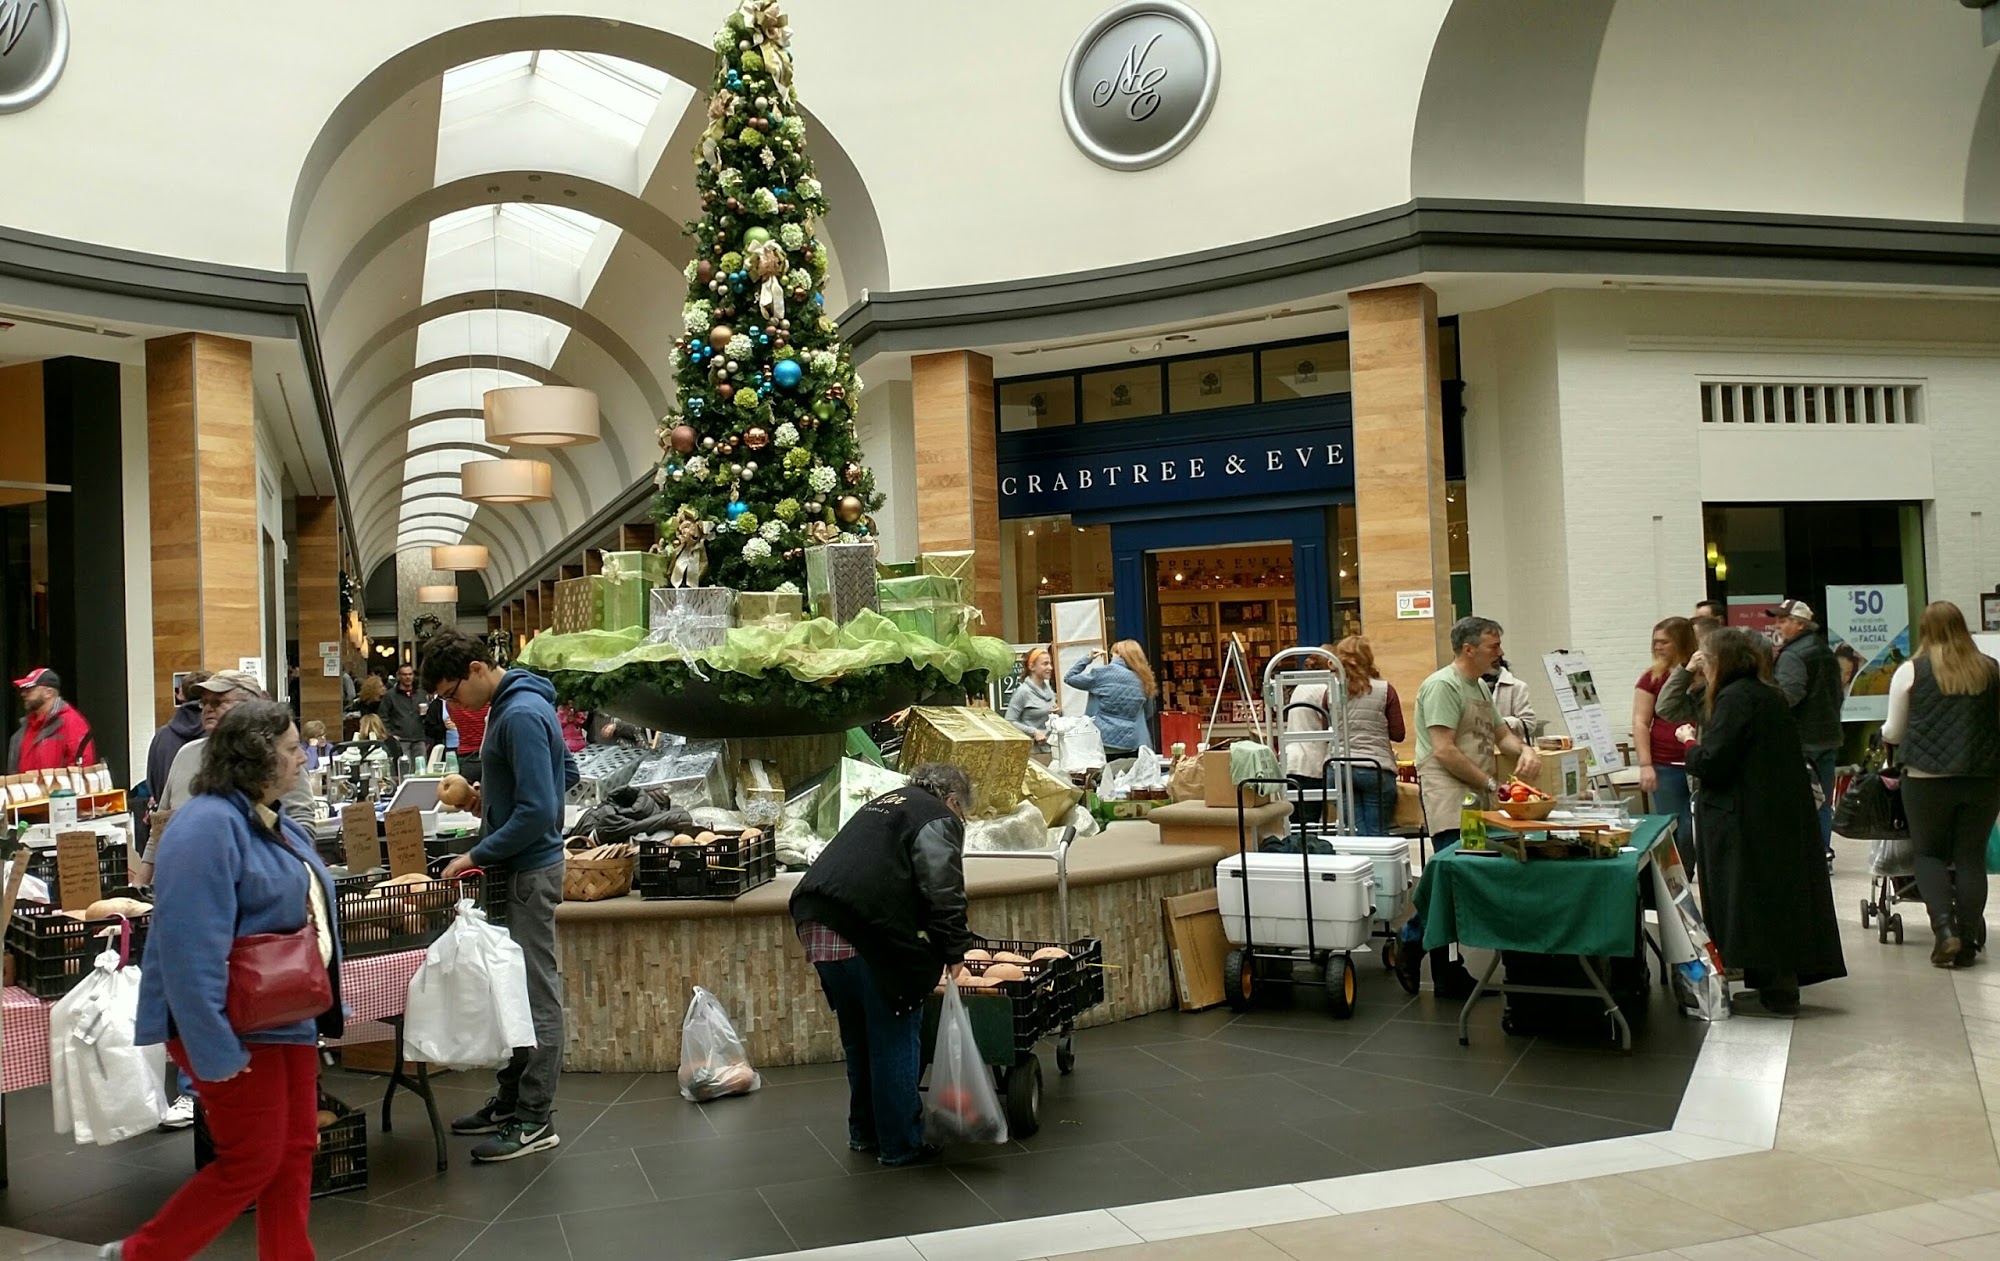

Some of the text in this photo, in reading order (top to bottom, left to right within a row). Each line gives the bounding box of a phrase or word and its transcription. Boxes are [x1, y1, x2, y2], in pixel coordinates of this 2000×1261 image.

[1001, 458, 1206, 496] CRABTREE
[1225, 454, 1246, 475] &
[1848, 590, 1883, 615] $50
[1849, 624, 1888, 633] MASSAGE
[1859, 634, 1887, 643] FACIAL
